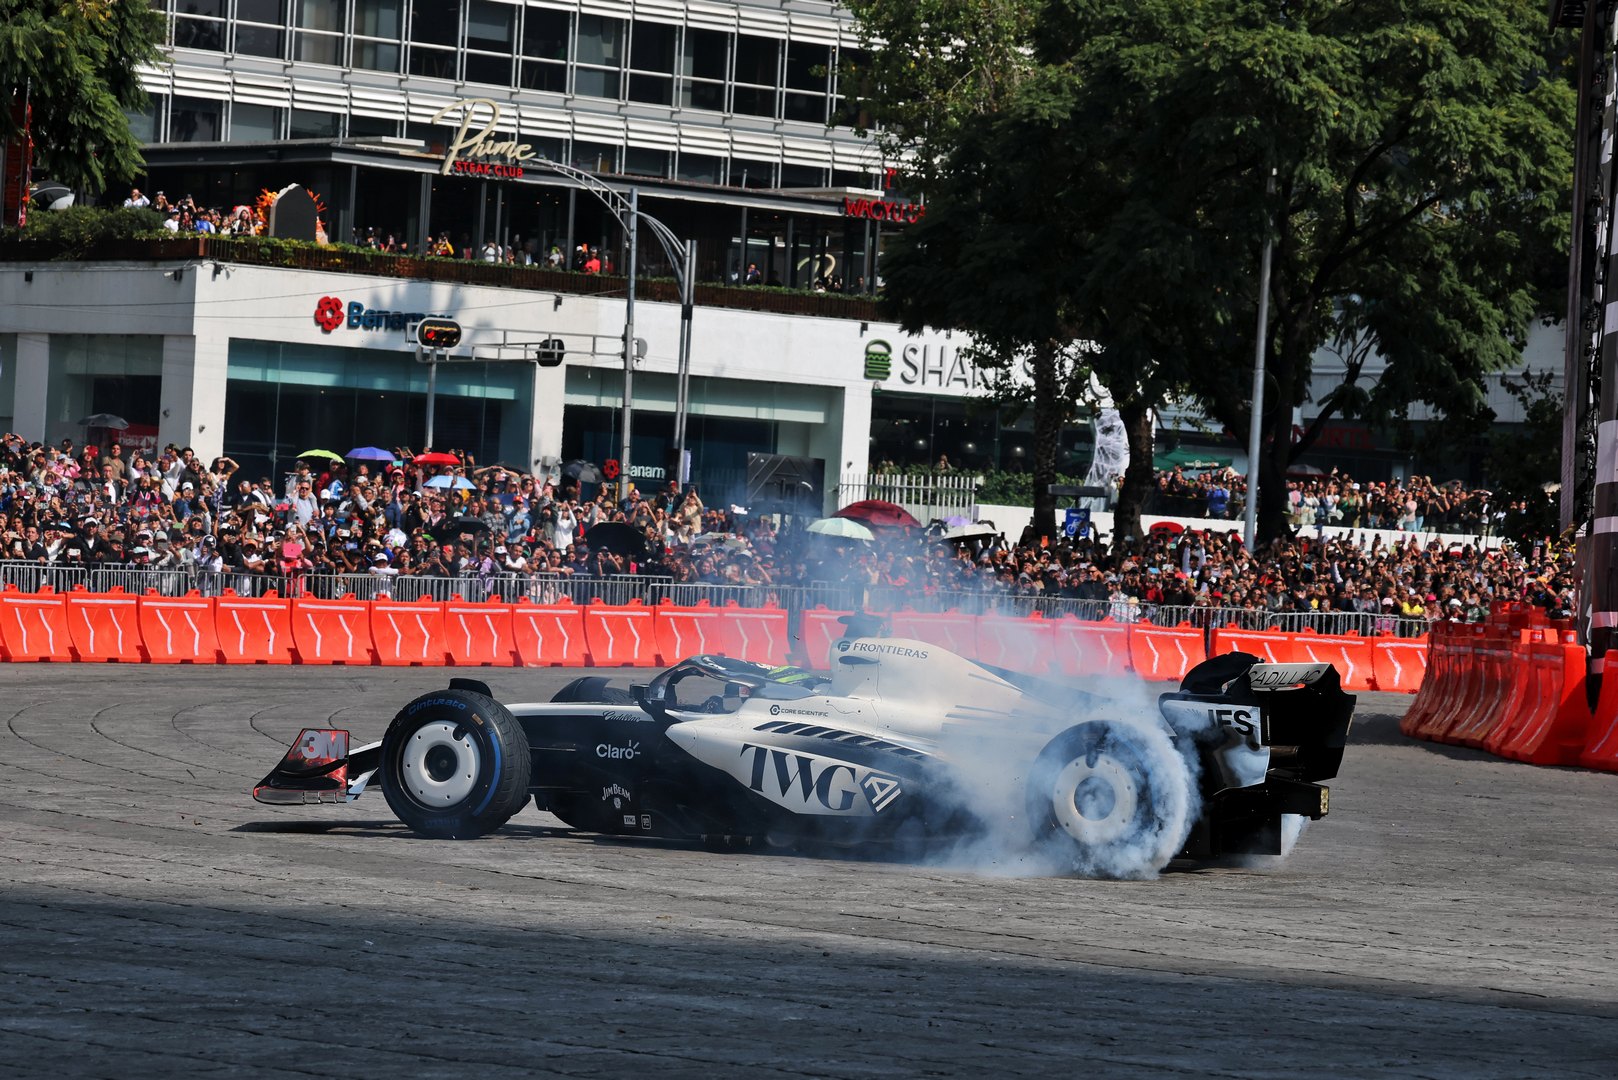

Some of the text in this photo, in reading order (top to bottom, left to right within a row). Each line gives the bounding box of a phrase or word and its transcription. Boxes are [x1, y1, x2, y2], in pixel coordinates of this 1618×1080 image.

[431, 98, 536, 176] Prime
[455, 161, 524, 178] STEAK CLUB
[347, 301, 453, 332] Banam
[629, 465, 666, 479] anam
[853, 642, 929, 659] FRONTIERAS
[408, 698, 467, 716] Cinturato
[797, 709, 828, 717] SCIENTIFIC
[301, 730, 345, 759] 3M
[596, 743, 635, 759] Claro
[740, 743, 857, 811] TWG
[602, 783, 631, 801] JIM BEAM
